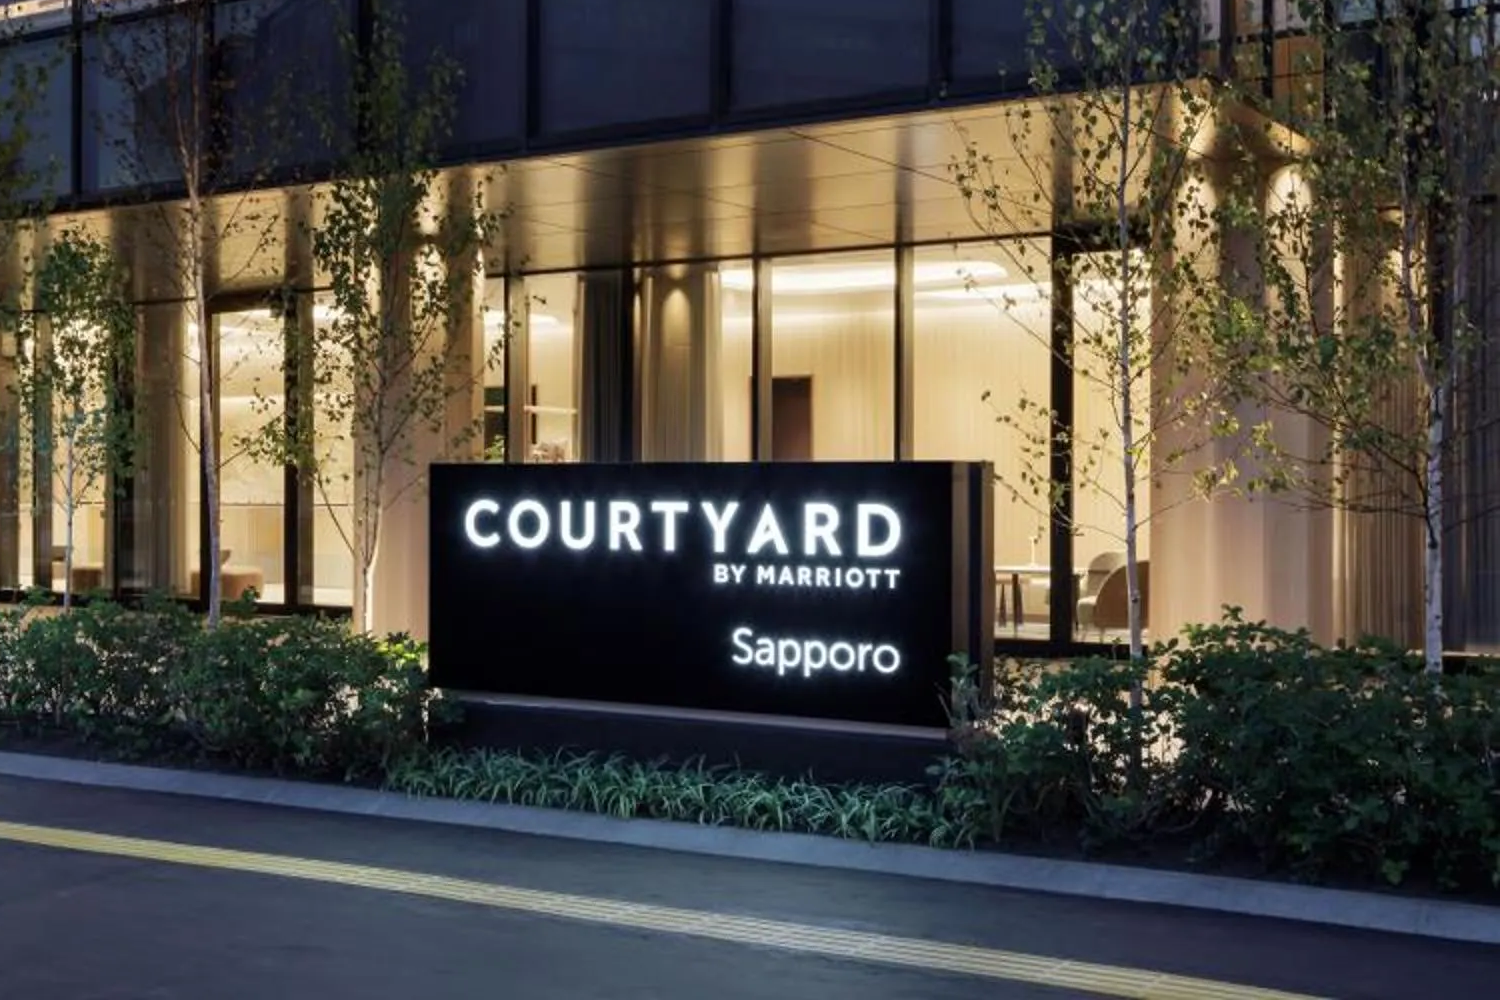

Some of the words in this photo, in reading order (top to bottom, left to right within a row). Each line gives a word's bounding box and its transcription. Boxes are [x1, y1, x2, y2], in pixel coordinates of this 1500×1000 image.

[464, 498, 902, 558] COURTYARD
[713, 563, 747, 584] BY
[756, 564, 901, 589] MARRIOTT
[731, 626, 901, 677] Sapporo
